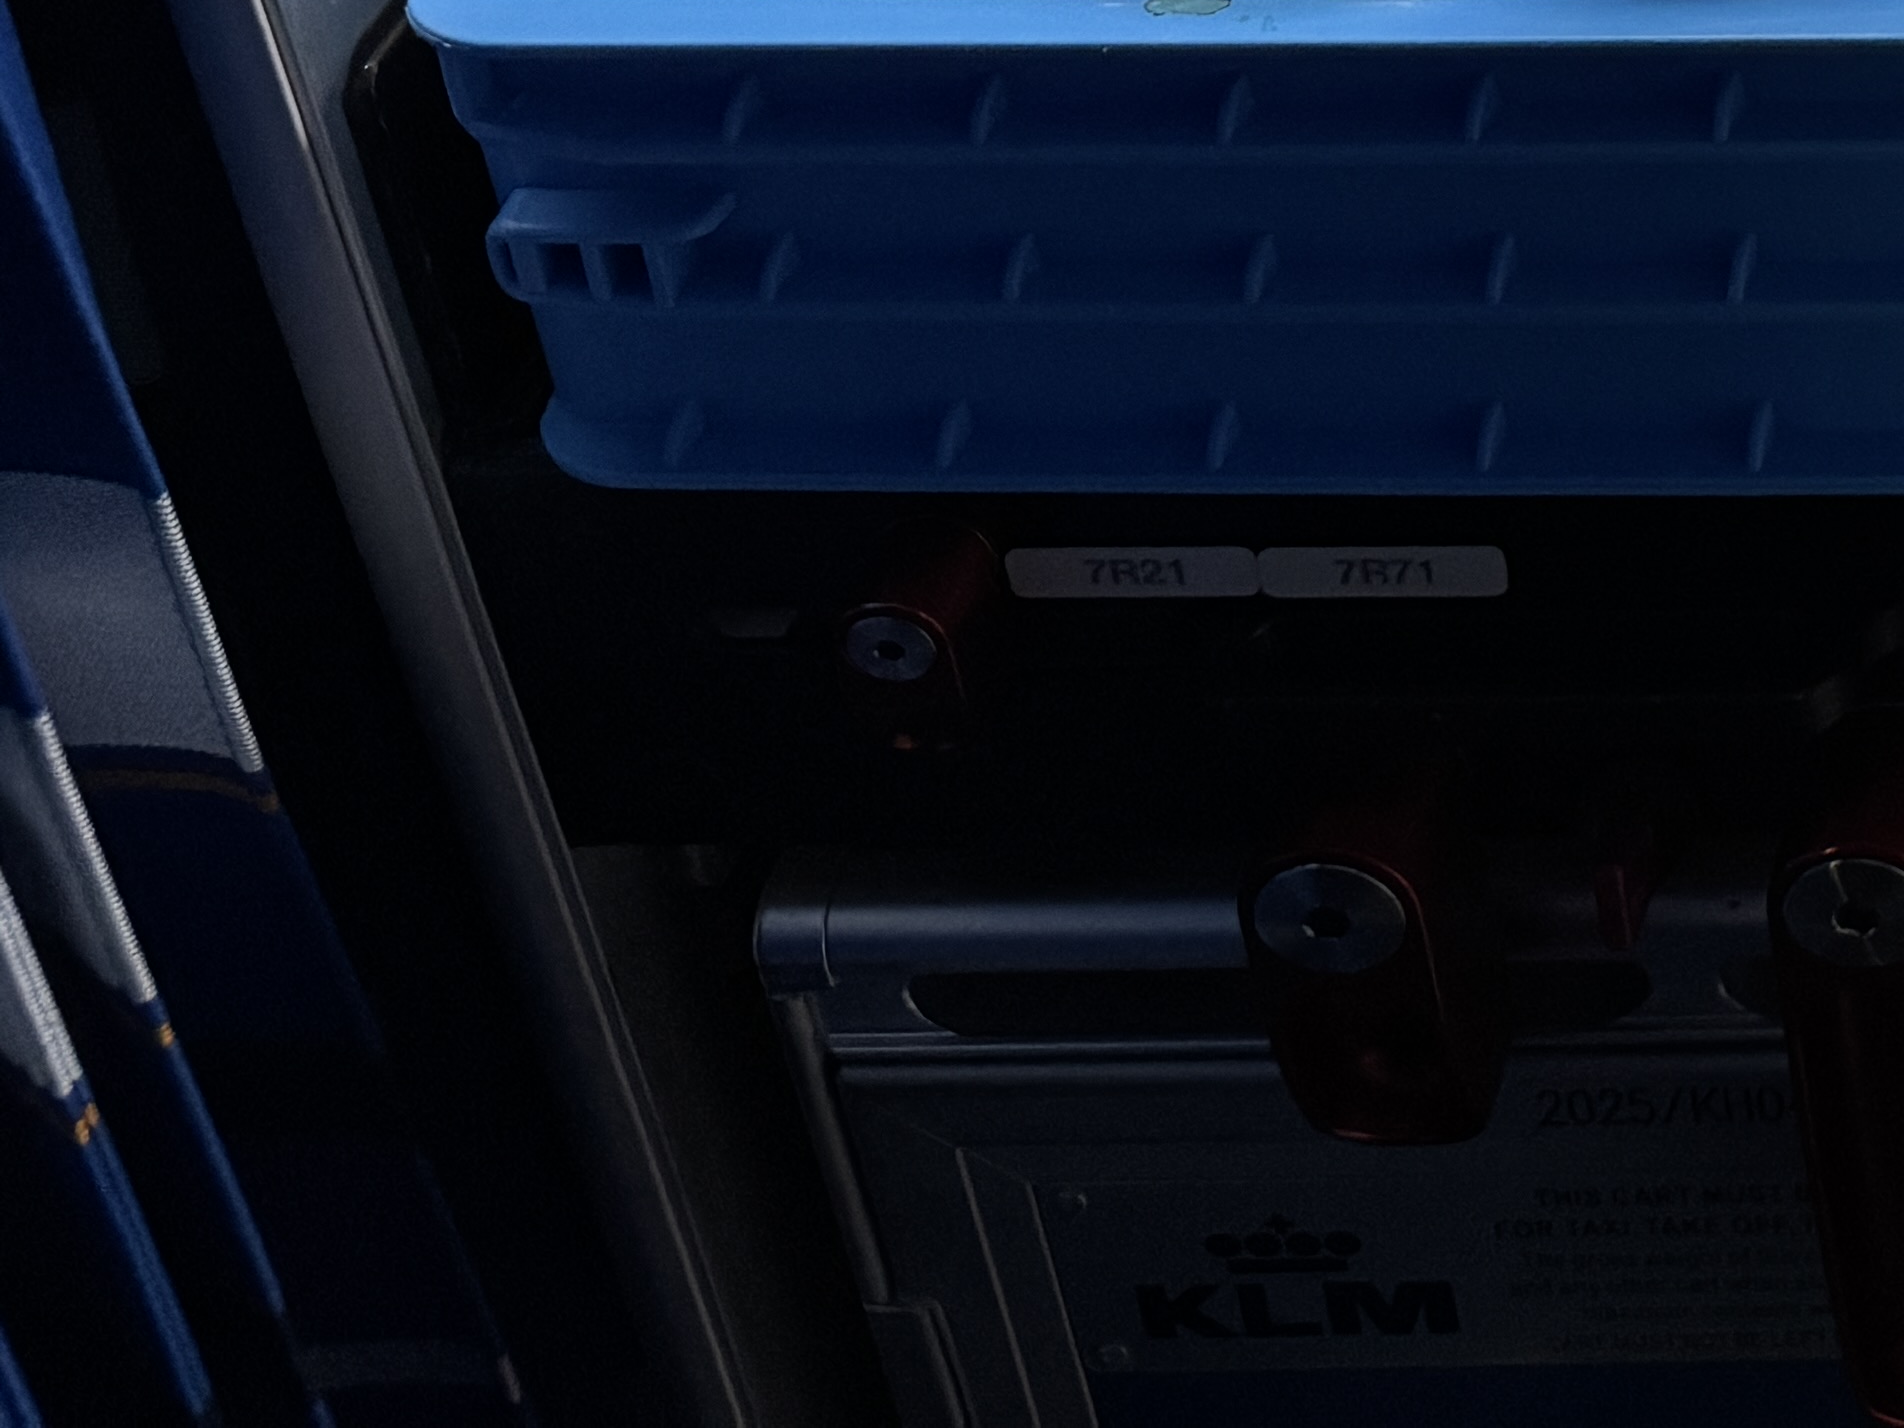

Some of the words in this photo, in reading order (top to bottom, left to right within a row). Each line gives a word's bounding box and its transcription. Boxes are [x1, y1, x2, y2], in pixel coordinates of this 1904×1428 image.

[1082, 557, 1186, 587] 7R21
[1333, 557, 1433, 587] 7R71
[1133, 1280, 1462, 1339] KLM
